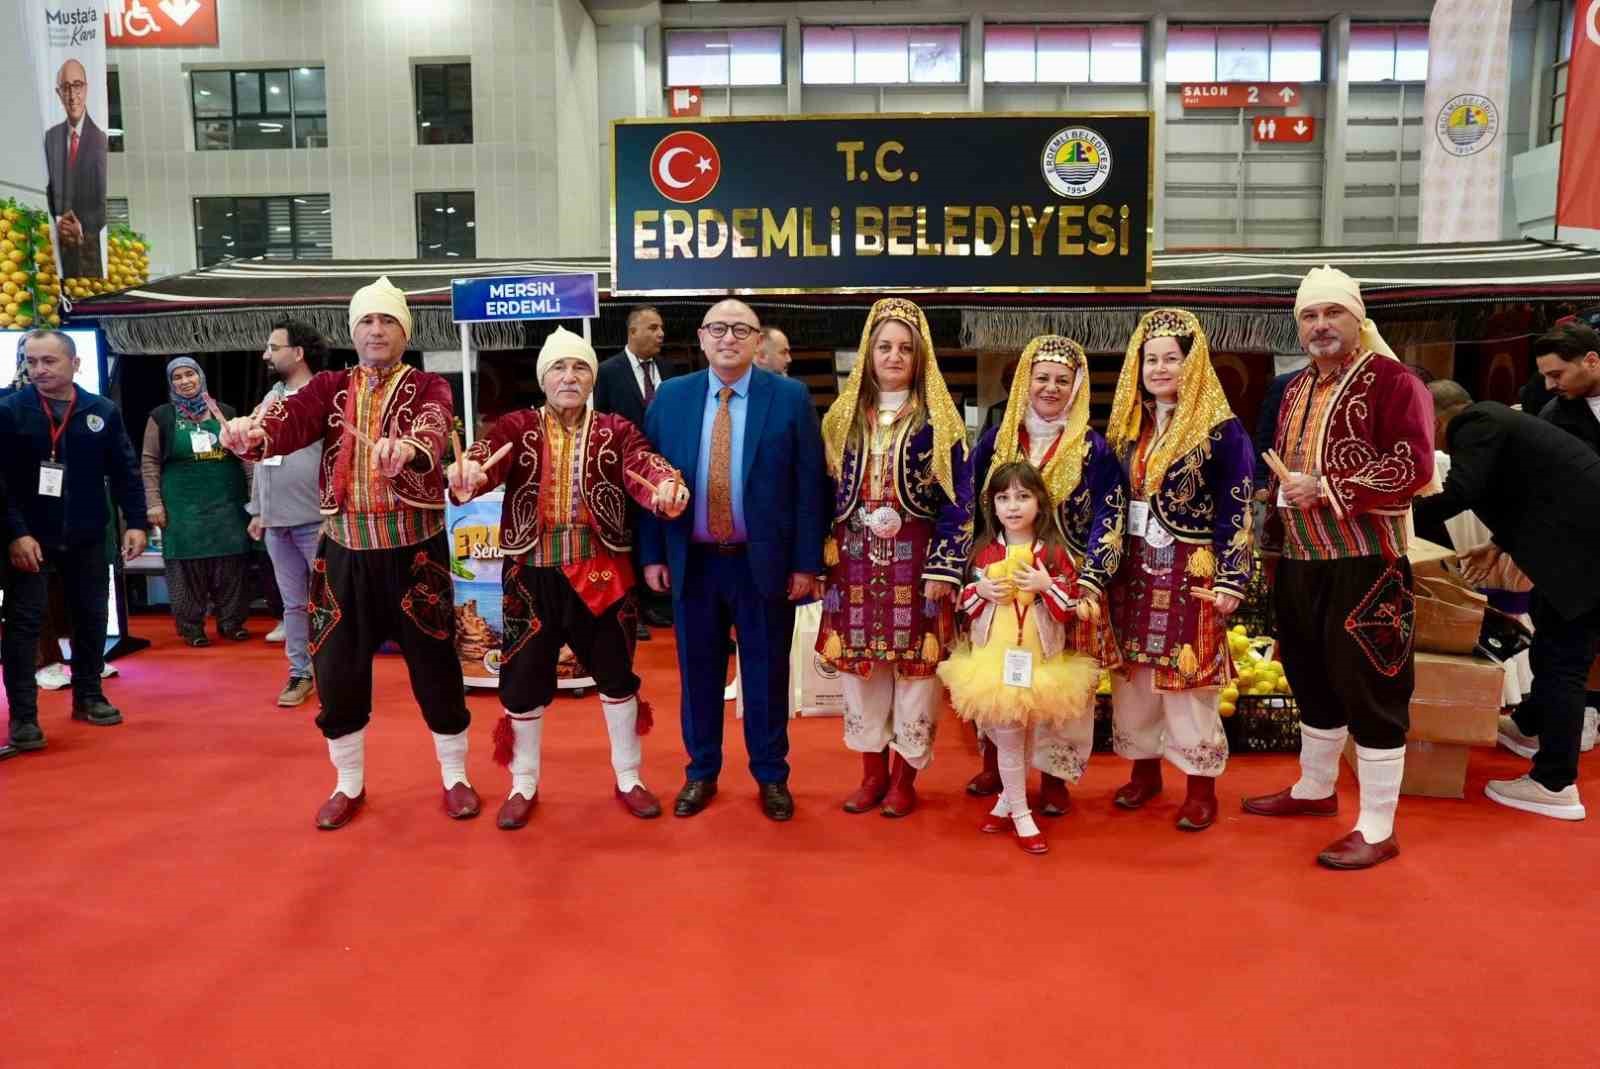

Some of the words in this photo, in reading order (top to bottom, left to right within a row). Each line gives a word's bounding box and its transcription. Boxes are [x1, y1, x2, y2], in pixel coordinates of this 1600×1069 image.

[1184, 86, 1228, 96] SALON
[1248, 86, 1259, 103] 2
[1067, 186, 1087, 194] 1954
